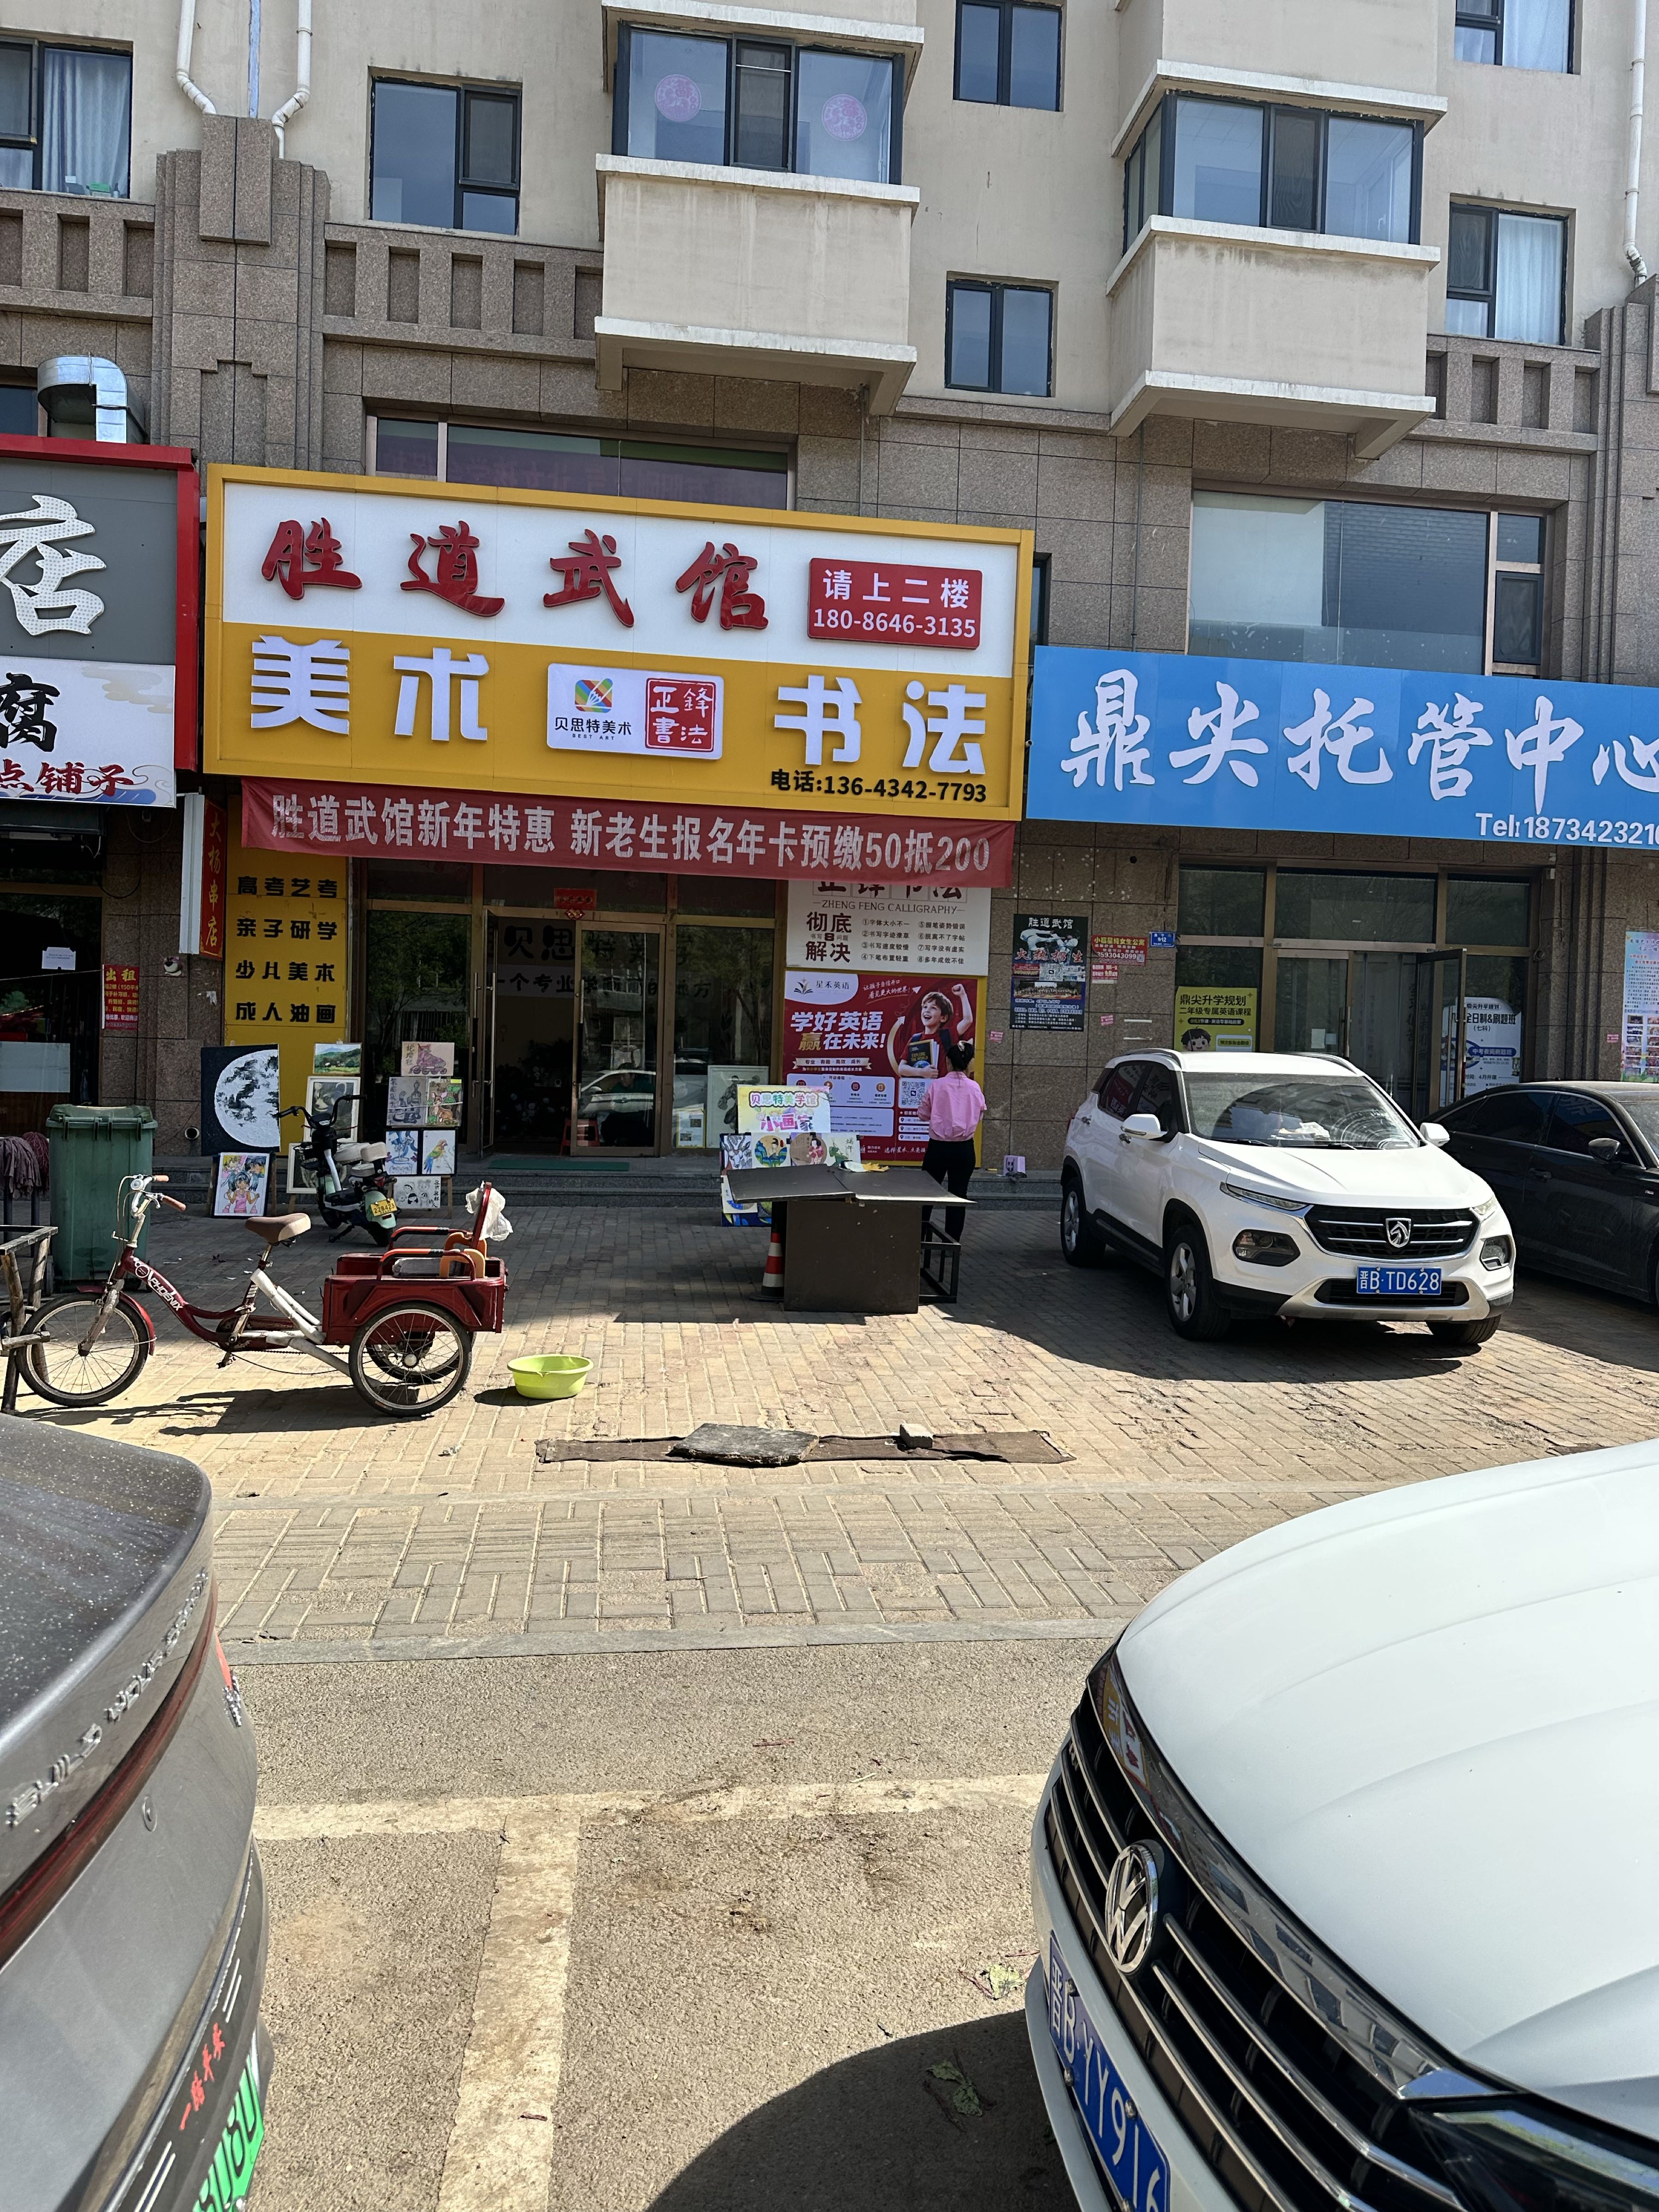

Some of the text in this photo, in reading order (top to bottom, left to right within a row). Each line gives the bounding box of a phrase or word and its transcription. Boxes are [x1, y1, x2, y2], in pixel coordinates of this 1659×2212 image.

[261, 517, 769, 630] 胜道武馆
[823, 569, 969, 610] 请上二楼
[813, 608, 977, 638] 180-8646-3135
[251, 635, 490, 741] 美术
[554, 717, 632, 735] 贝思特美术
[774, 674, 987, 775] 书法
[1060, 668, 1659, 815] 鼎尖托管中心
[771, 768, 987, 803] 电话:136-4342-7793
[271, 794, 990, 875] 胜道武馆新年特惠 新老生报名年卡预缴50抵200
[237, 876, 337, 898] 高考艺考
[822, 900, 957, 914] ZHENG FENG CALLIGRAPHY
[236, 918, 337, 941] 亲子研学
[806, 911, 852, 933] 彻底
[1028, 917, 1074, 930] 胜道武馆
[806, 941, 851, 963] 解决
[1014, 947, 1083, 963] 火热招生
[106, 967, 136, 982] 出租
[235, 959, 335, 982] 少儿美术
[815, 980, 850, 990] 星禾英语
[1179, 1006, 1252, 1016] 二年级专属英语课程
[1180, 994, 1247, 1006] 鼎尖升学规划
[235, 1001, 336, 1024] 成人油画
[790, 1011, 884, 1032] 学好英语
[750, 1091, 817, 1106] 贝思特美学馆
[760, 1112, 815, 1132] 小画家
[1359, 1270, 1440, 1291] 晋B·TD628
[148, 1277, 184, 1312] PHOENIX
